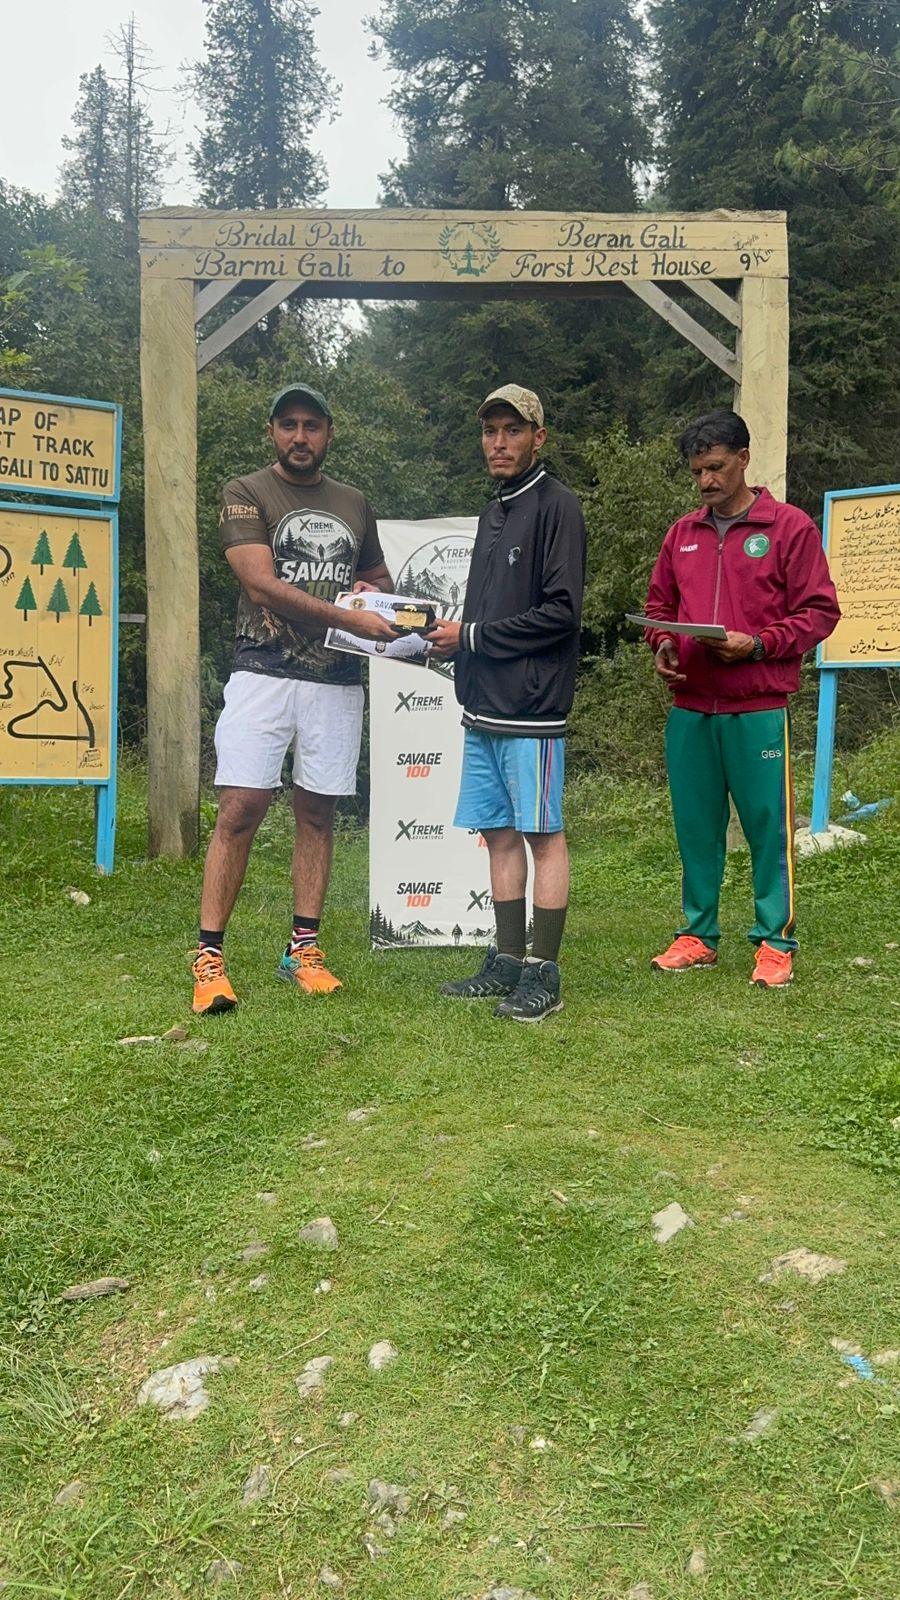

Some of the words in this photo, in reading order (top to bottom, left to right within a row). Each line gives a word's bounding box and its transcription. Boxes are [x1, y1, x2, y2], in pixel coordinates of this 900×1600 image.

[215, 220, 296, 248] Bridal
[305, 221, 366, 248] Path
[557, 220, 633, 249] Beran
[640, 224, 688, 249] Gali
[194, 249, 288, 278] Barmi
[297, 250, 353, 278] Gali
[379, 254, 405, 277] to
[510, 253, 574, 279] Forst
[581, 252, 639, 277] Rest
[651, 253, 718, 277] House
[740, 253, 751, 271] 9
[0, 406, 22, 426] AP
[34, 411, 59, 431] OF
[32, 434, 95, 458] TRACK
[0, 456, 33, 479] GALI
[40, 460, 59, 481] TO
[65, 464, 109, 488] SATTU
[299, 518, 335, 532] XTREME
[429, 544, 474, 566] XTREM
[280, 560, 352, 586] SAVAGE
[375, 600, 394, 610] SAVA
[394, 690, 444, 714] XTREME
[397, 752, 442, 766] SAVAGE
[761, 749, 782, 759] GBS
[406, 765, 431, 778] 100
[395, 818, 444, 841] XTREME
[397, 882, 443, 895] SAVAGE
[407, 894, 432, 908] 100
